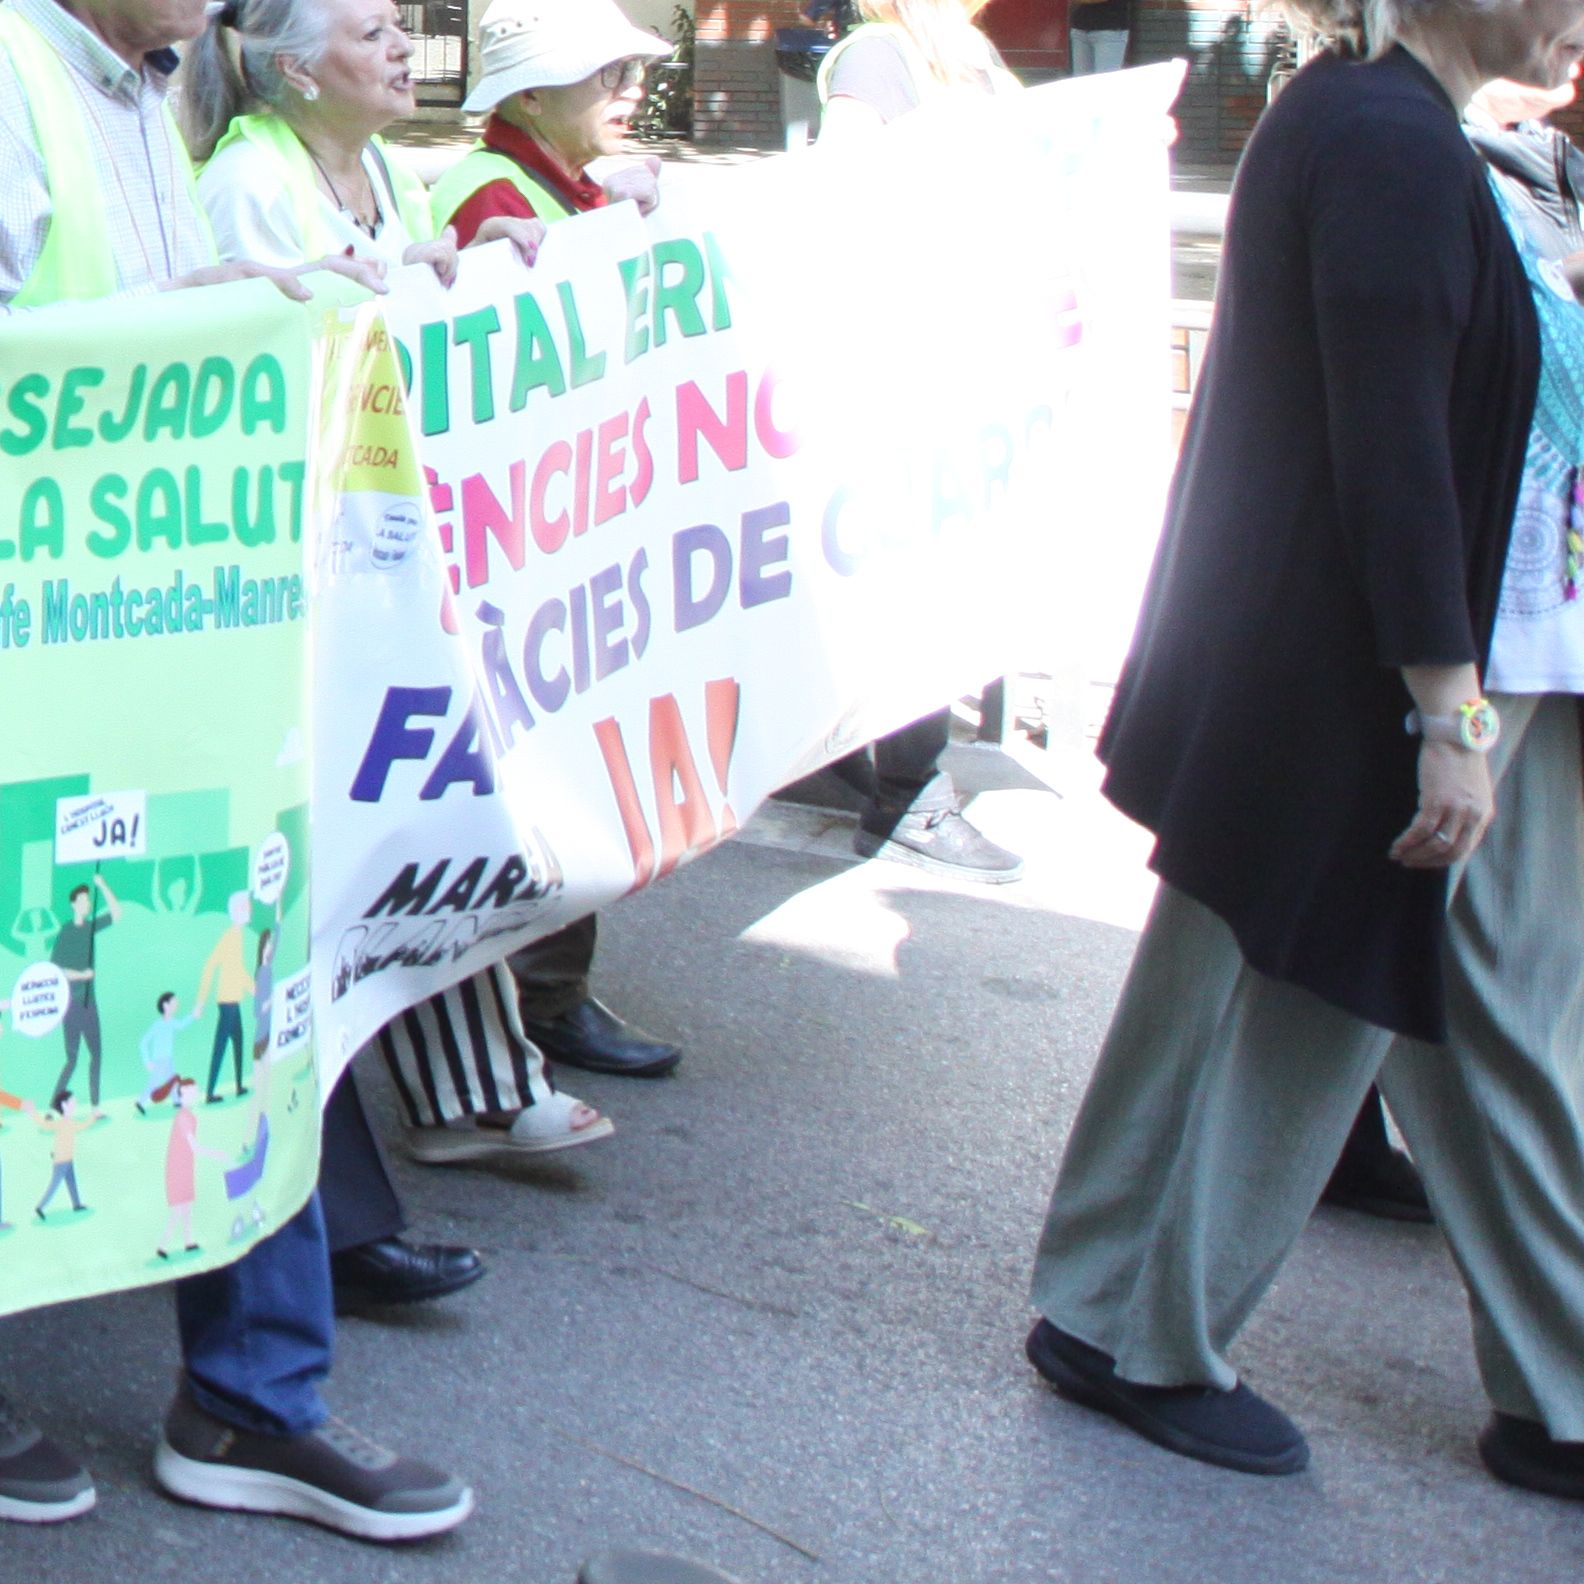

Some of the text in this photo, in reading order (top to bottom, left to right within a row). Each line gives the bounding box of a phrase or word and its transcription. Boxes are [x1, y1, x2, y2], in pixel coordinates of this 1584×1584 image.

[394, 279, 609, 437] ITAL
[85, 457, 306, 560] SALUT
[670, 500, 795, 636] DE
[92, 812, 140, 849] JA!
